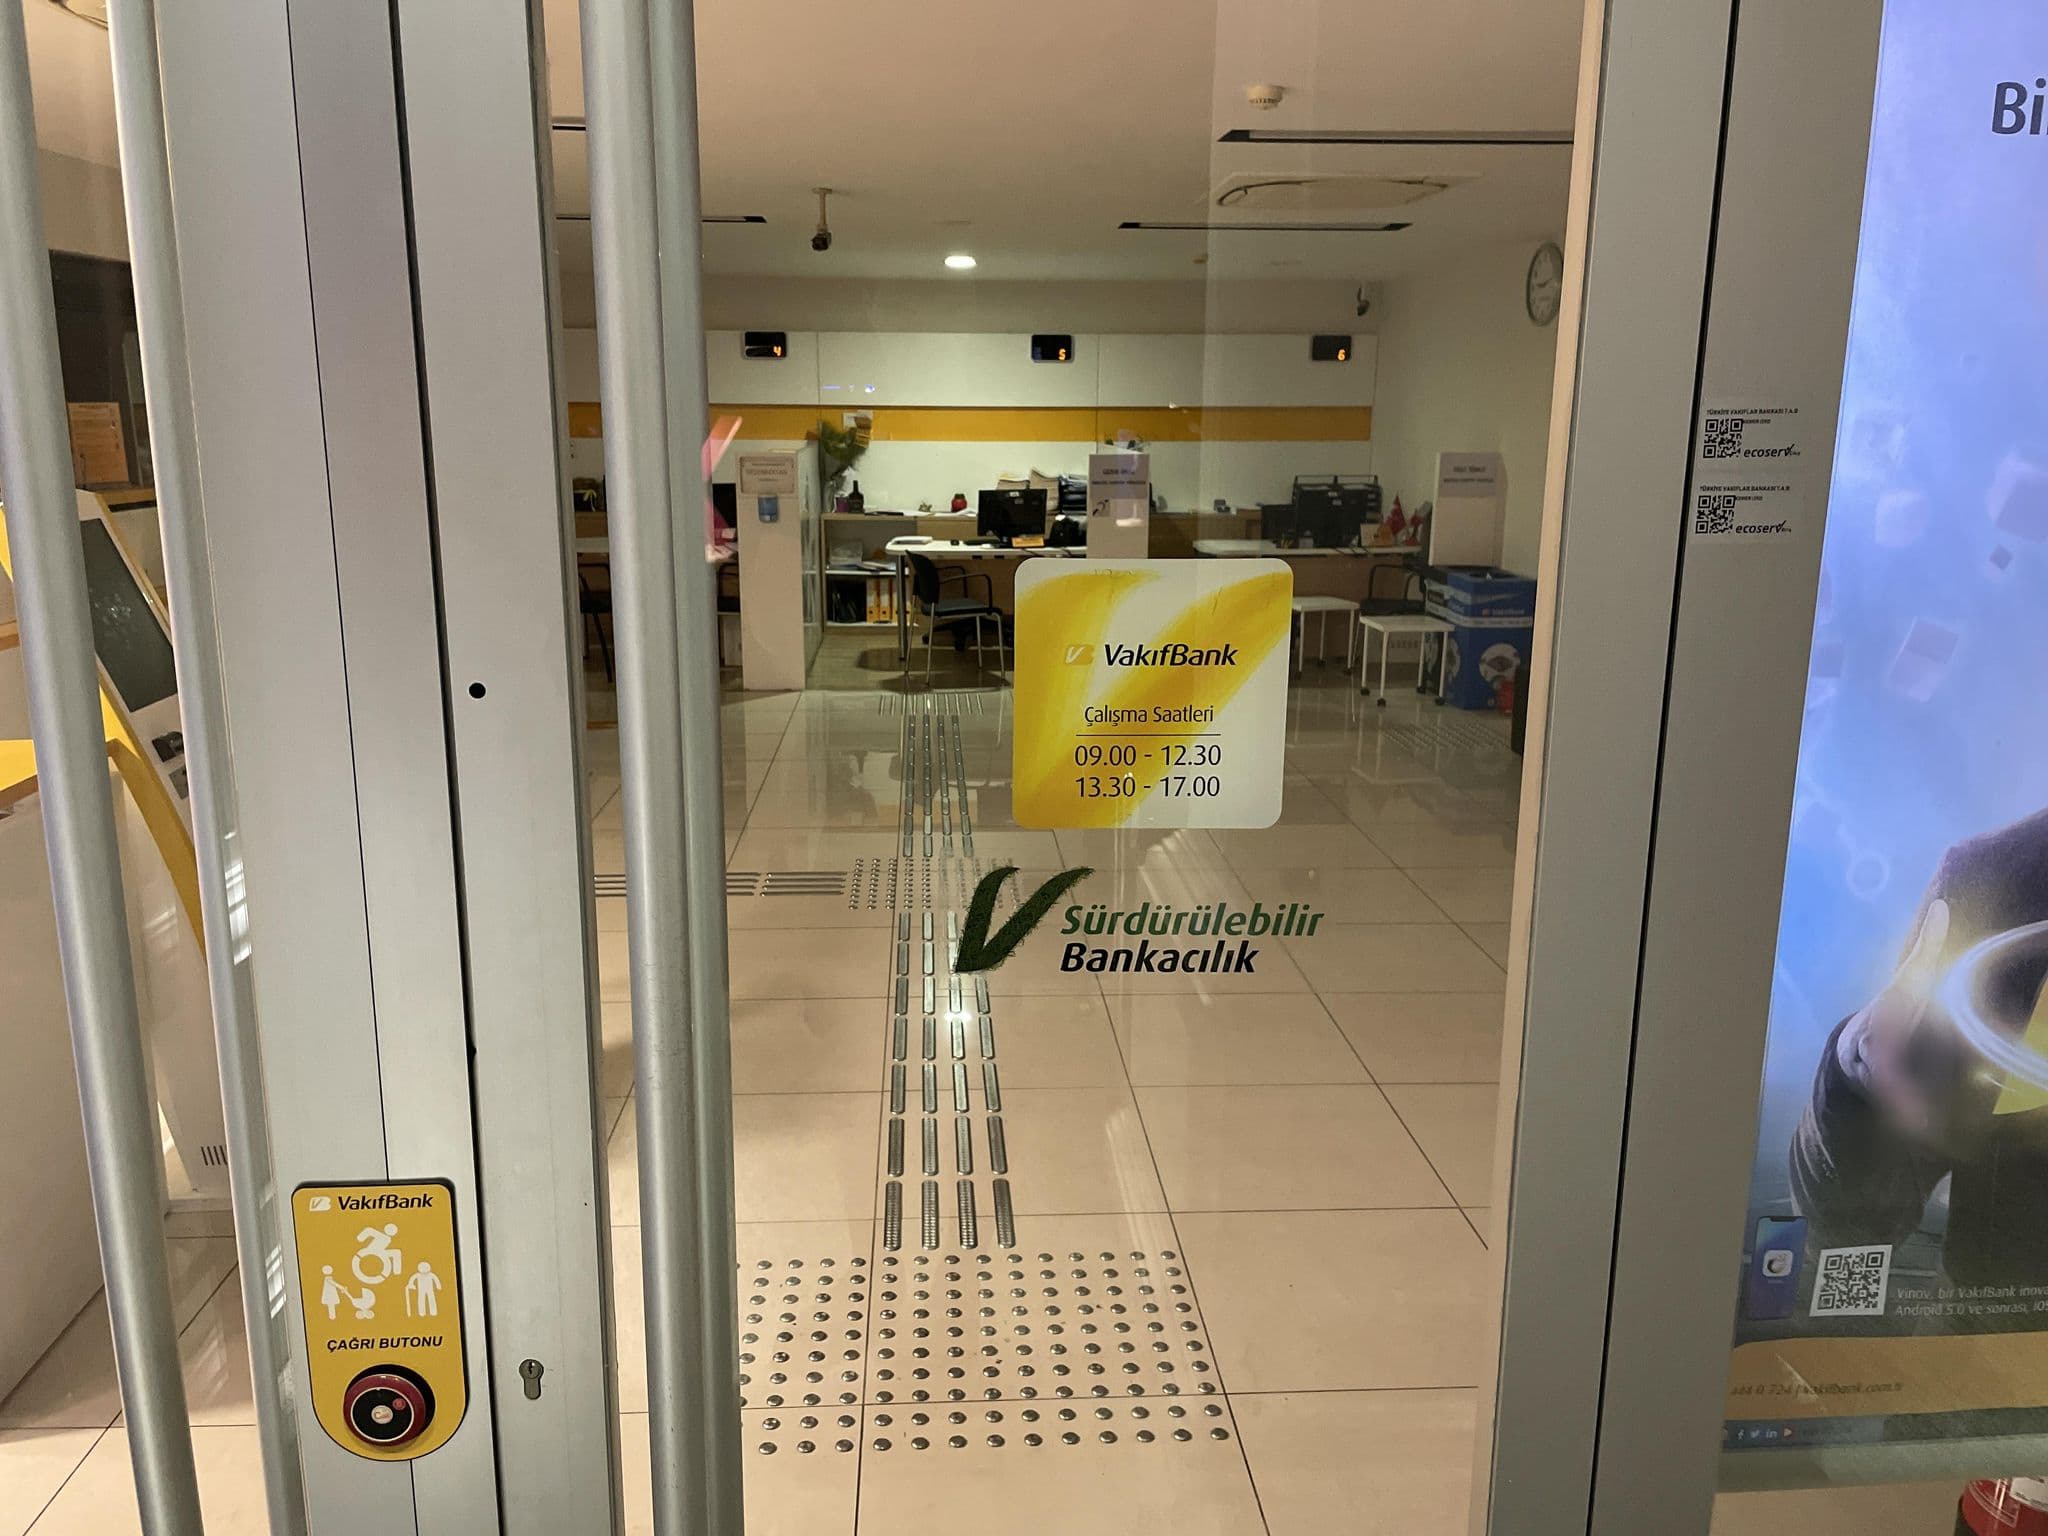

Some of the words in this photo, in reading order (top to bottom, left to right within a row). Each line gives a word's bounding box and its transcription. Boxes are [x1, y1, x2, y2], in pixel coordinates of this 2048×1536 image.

[1991, 77, 2048, 135] Bi
[773, 345, 781, 357] 4
[1058, 348, 1066, 361] 5
[1337, 348, 1346, 361] 6
[1104, 643, 1239, 667] VakıfBank
[1084, 705, 1148, 727] Çalışma
[1152, 704, 1214, 723] Saatleri
[1074, 745, 1137, 766] 09.00
[1160, 744, 1222, 766] 12.30
[1075, 776, 1136, 797] 13.30
[1159, 776, 1220, 797] 17.00
[1060, 902, 1325, 937] Sürdürülebilir
[1060, 939, 1260, 973] Bankacılık
[337, 1193, 434, 1211] VakıfBank
[1896, 1303, 1943, 1317] Android
[1968, 1305, 1984, 1315] ve
[326, 1336, 376, 1353] ÇAĞRI
[378, 1335, 443, 1349] BUTONU
